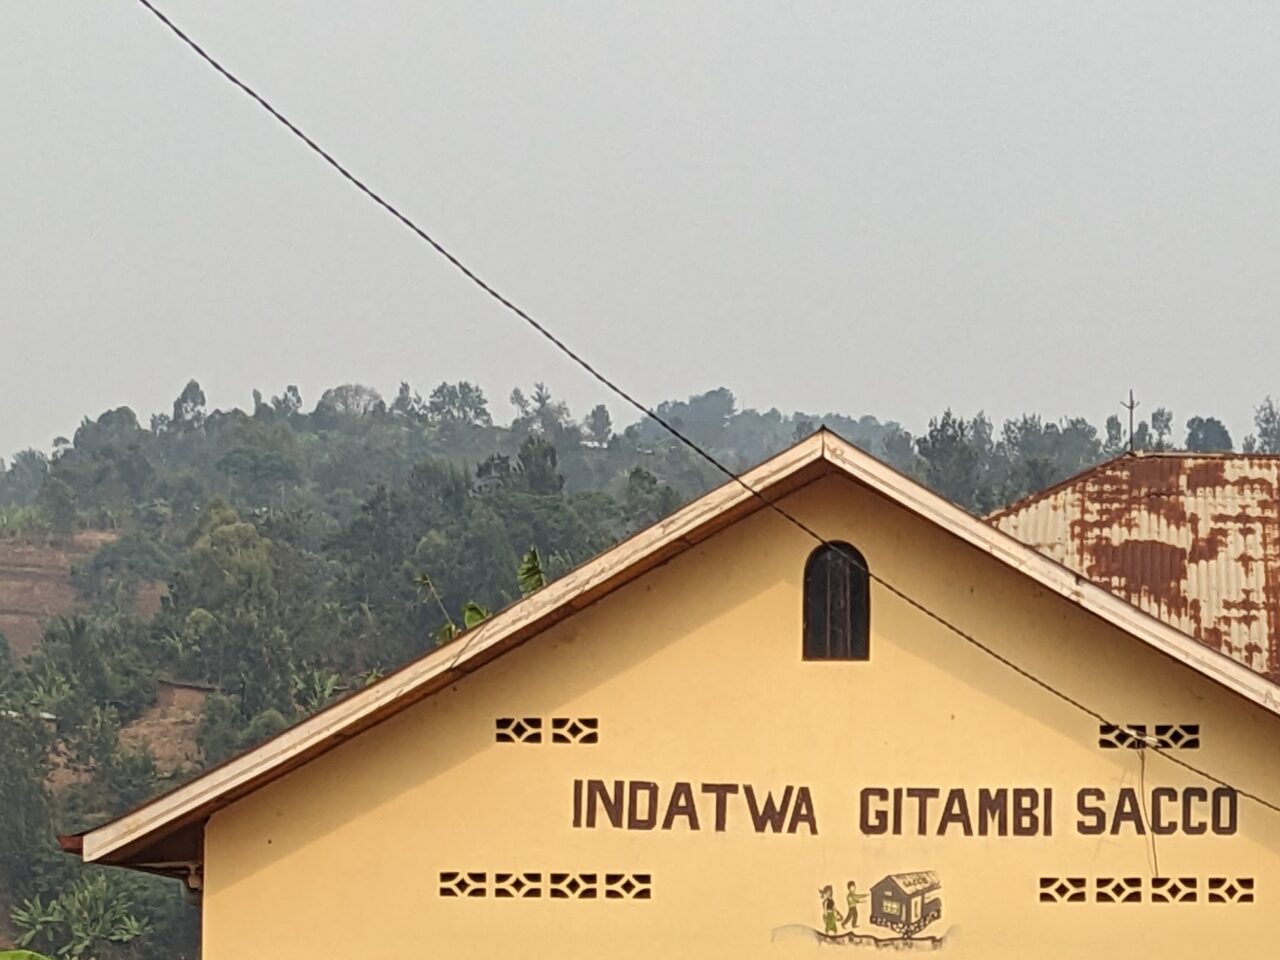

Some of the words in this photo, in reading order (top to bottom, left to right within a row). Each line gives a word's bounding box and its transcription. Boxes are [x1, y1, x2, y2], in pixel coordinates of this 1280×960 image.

[573, 779, 818, 834] INDATWA
[860, 787, 1053, 836] GITAMBI
[1077, 786, 1238, 835] SACCO
